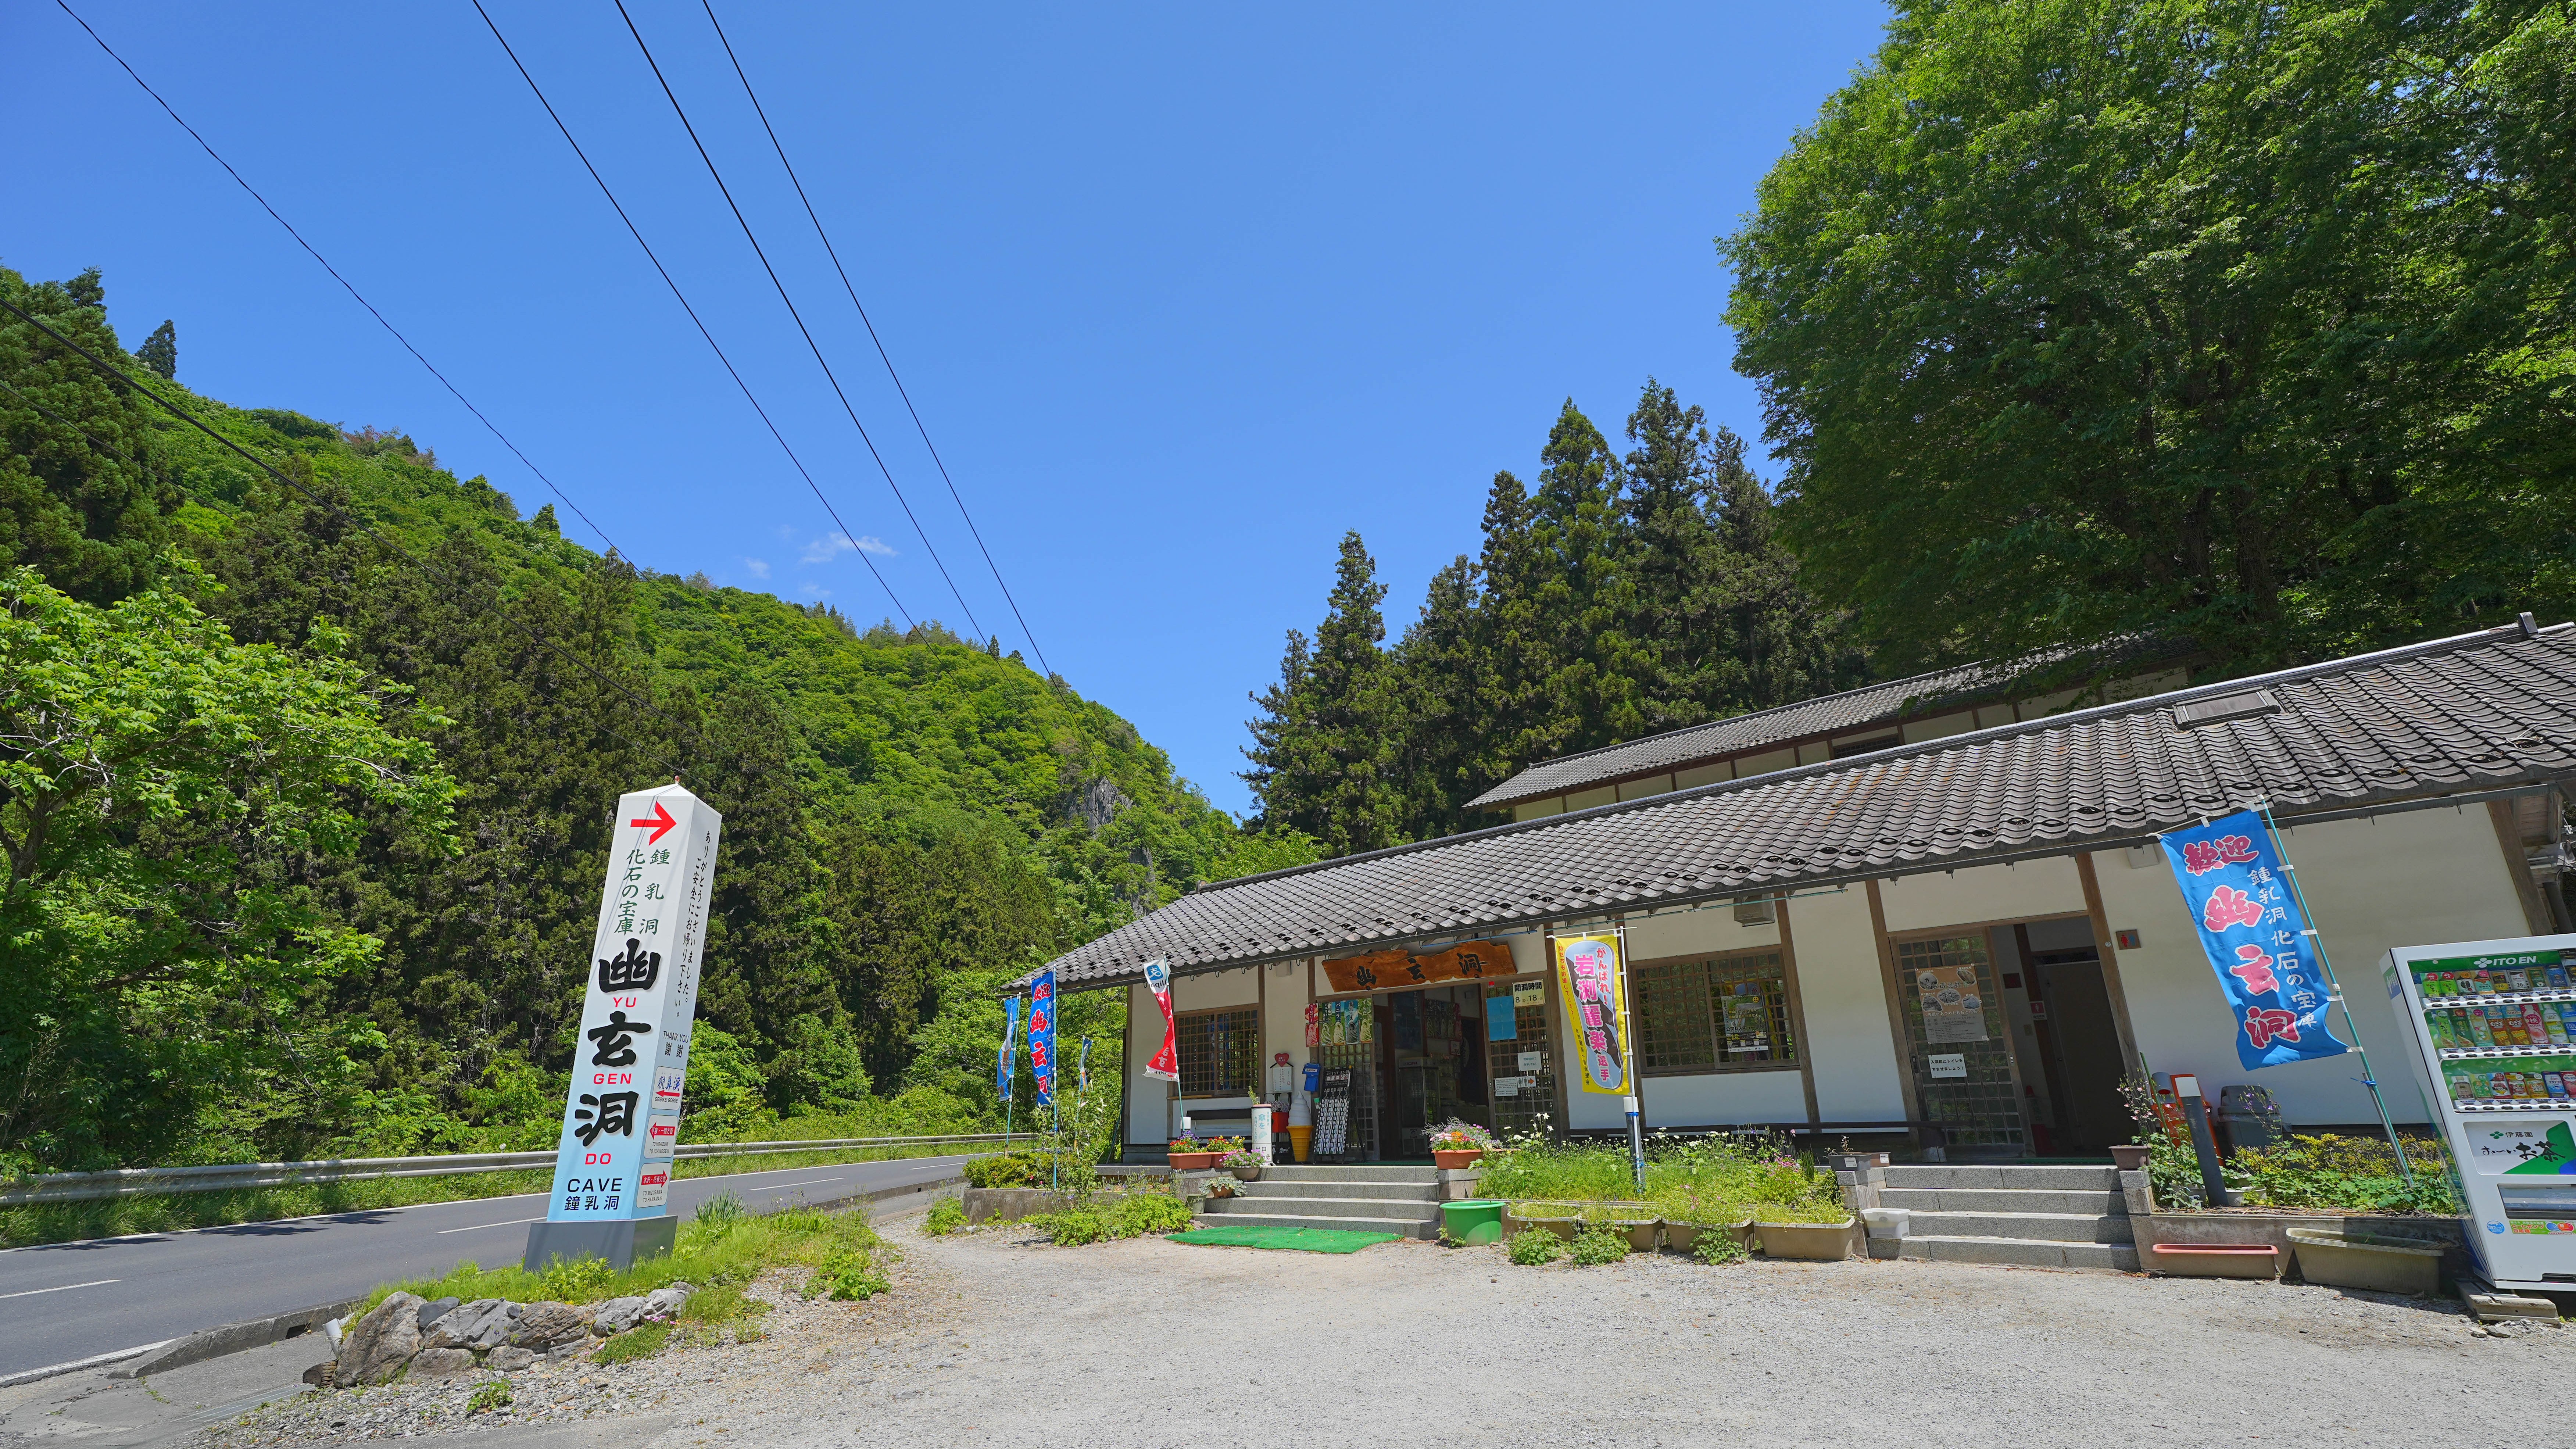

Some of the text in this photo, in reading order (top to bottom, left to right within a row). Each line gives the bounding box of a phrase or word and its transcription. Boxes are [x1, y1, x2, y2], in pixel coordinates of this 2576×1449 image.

[2182, 834, 2259, 877] 歓迎
[614, 849, 645, 936] 化石の宝庫
[639, 849, 670, 935] 鍾乳洞
[675, 858, 701, 1017] ご安全にお帰り下さい。
[2204, 884, 2302, 1049] 幽玄洞
[2493, 956, 2536, 966] ITO EN
[1357, 953, 1482, 986] 幽玄洞
[1597, 947, 1610, 1005] がんばれ！
[1514, 982, 1542, 992] 開洞時間
[613, 997, 636, 1008] YU
[663, 1030, 689, 1043] THANK YOU
[593, 1073, 632, 1085] GEN
[1258, 1113, 1265, 1130] 傘を
[585, 1153, 611, 1165] DO
[567, 1178, 623, 1192] CAVE
[564, 1195, 619, 1210] 鐘乳洞
